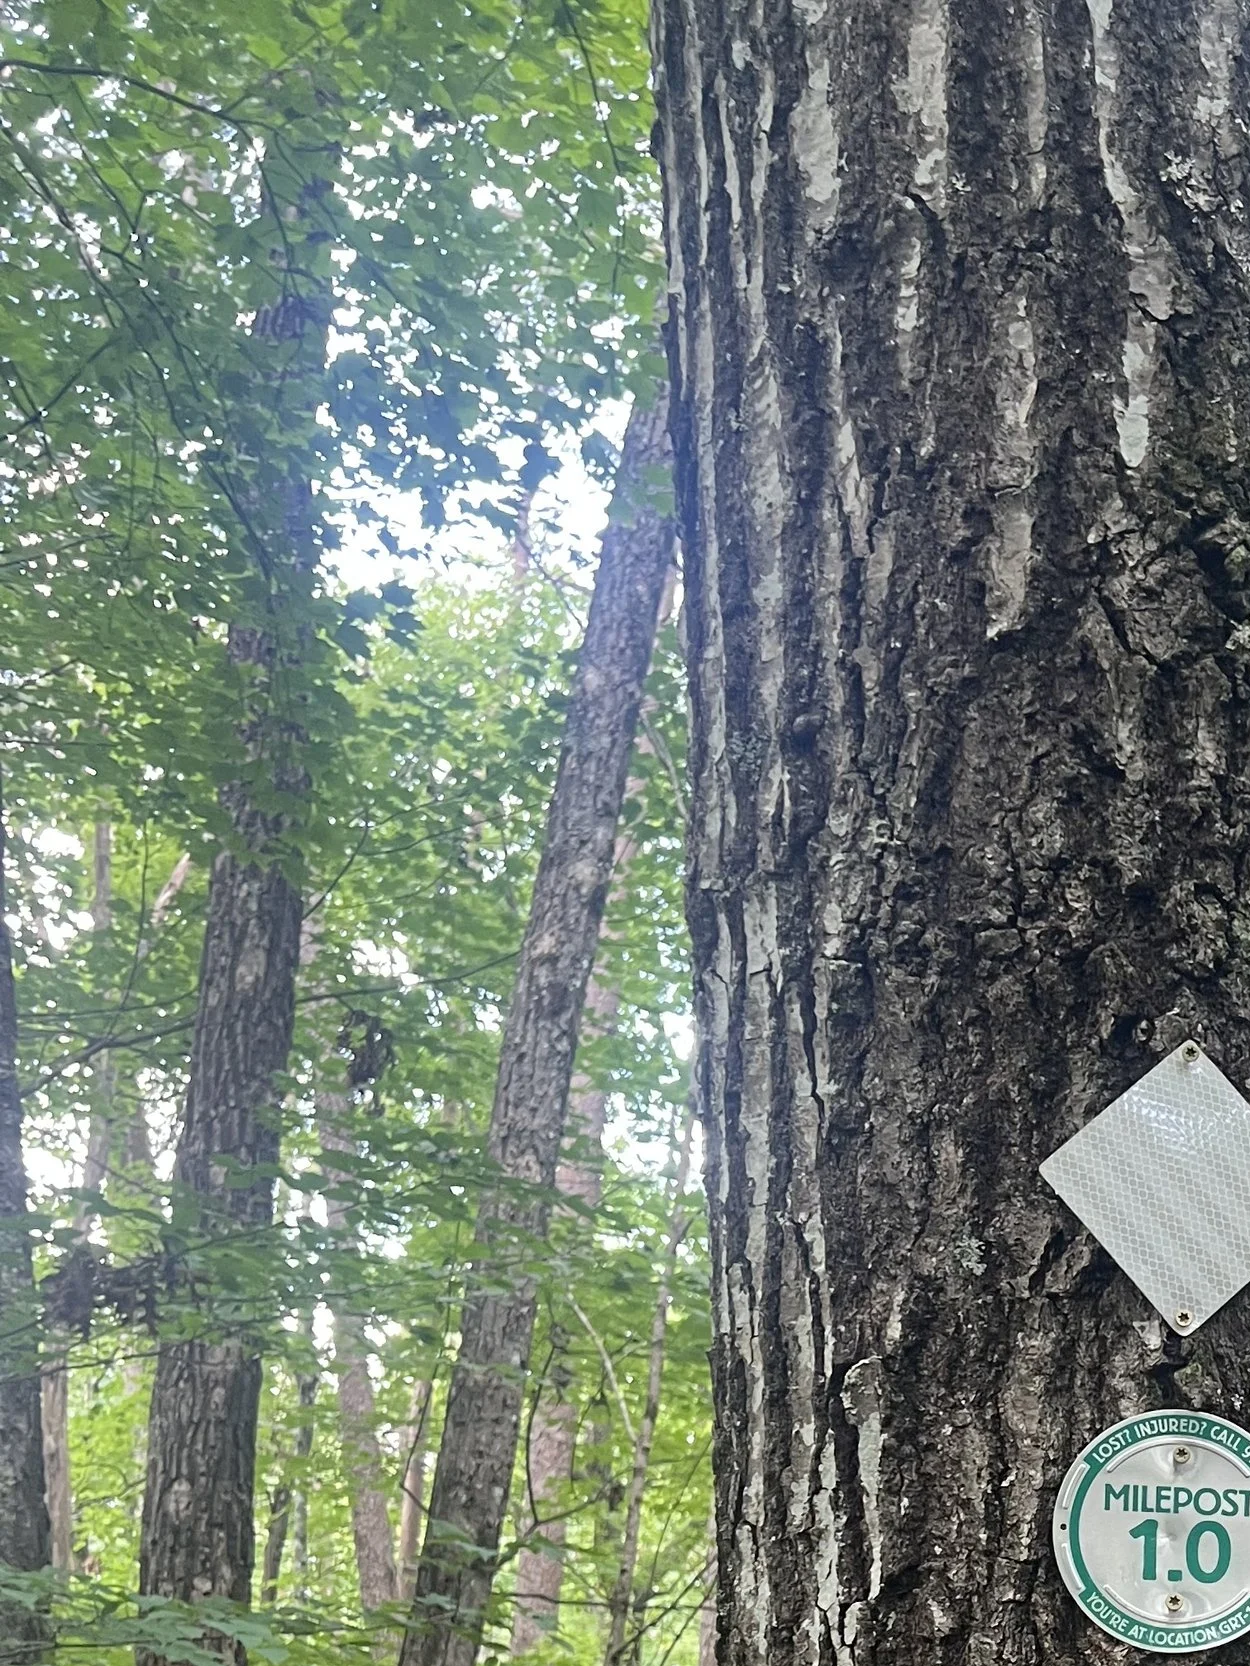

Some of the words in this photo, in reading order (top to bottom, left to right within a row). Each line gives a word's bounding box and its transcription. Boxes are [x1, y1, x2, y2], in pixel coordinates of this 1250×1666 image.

[1092, 1430, 1132, 1464] LOST?
[1134, 1418, 1206, 1438] INJURED?
[1210, 1426, 1241, 1452] CALL
[1129, 1518, 1231, 1584] 1.0
[1086, 1591, 1128, 1633] YOU'RE
[1129, 1625, 1148, 1640] AT
[1148, 1627, 1217, 1646] LOCATION
